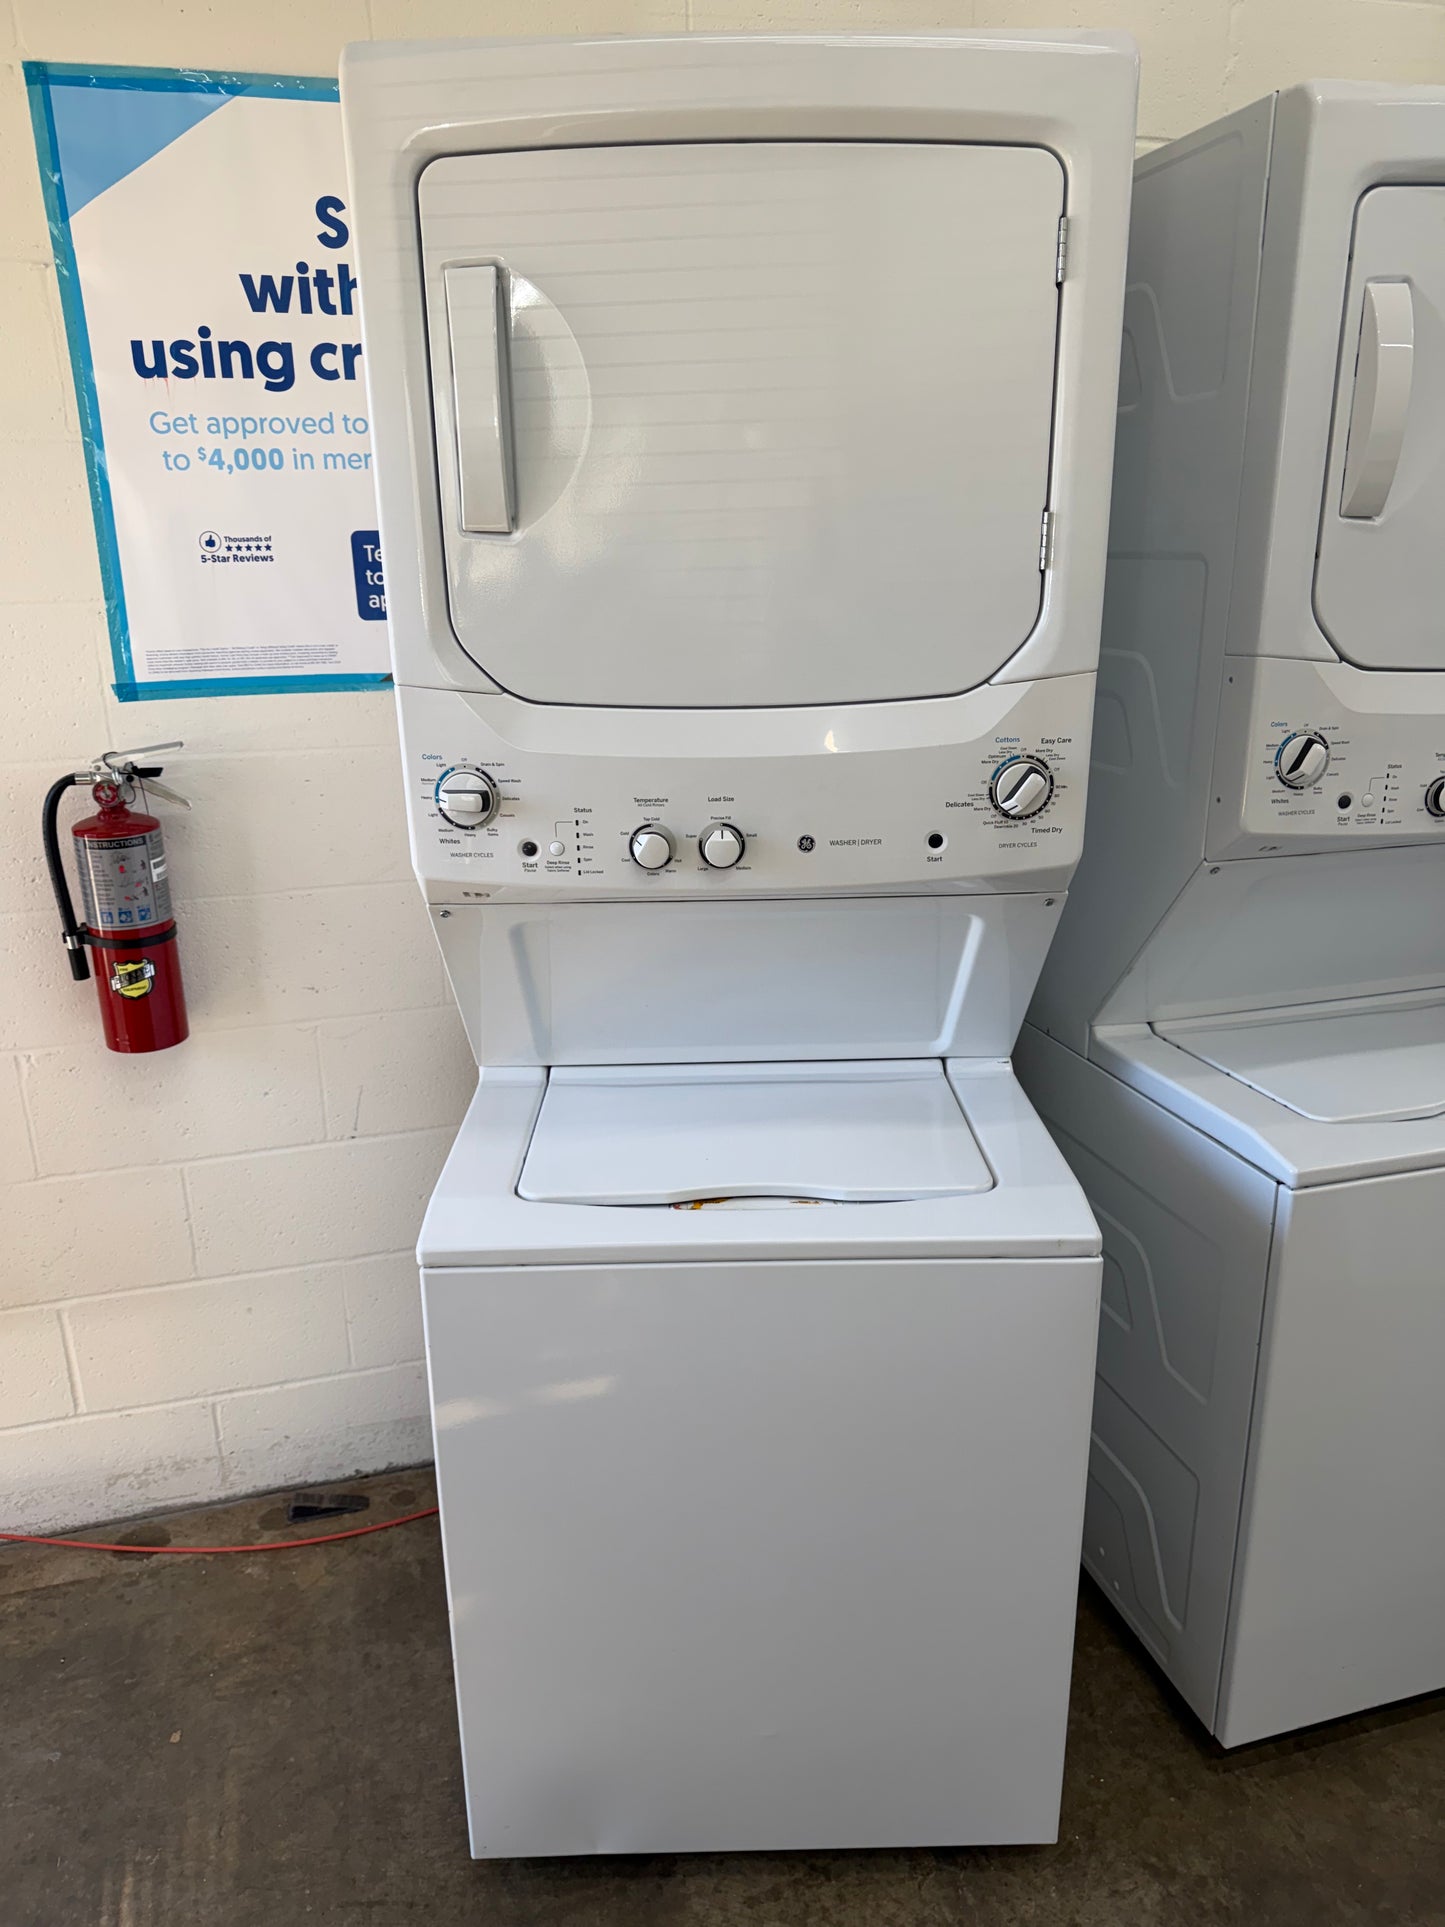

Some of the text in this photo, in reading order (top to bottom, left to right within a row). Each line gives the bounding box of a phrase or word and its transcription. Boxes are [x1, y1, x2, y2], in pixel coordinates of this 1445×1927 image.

[130, 325, 296, 392] using
[150, 411, 369, 439] Get approved to
[162, 446, 372, 475] to $4,000 in mer
[223, 535, 263, 543] Thousands
[200, 553, 274, 563] 5-Star Reviews
[422, 753, 443, 761] Colors
